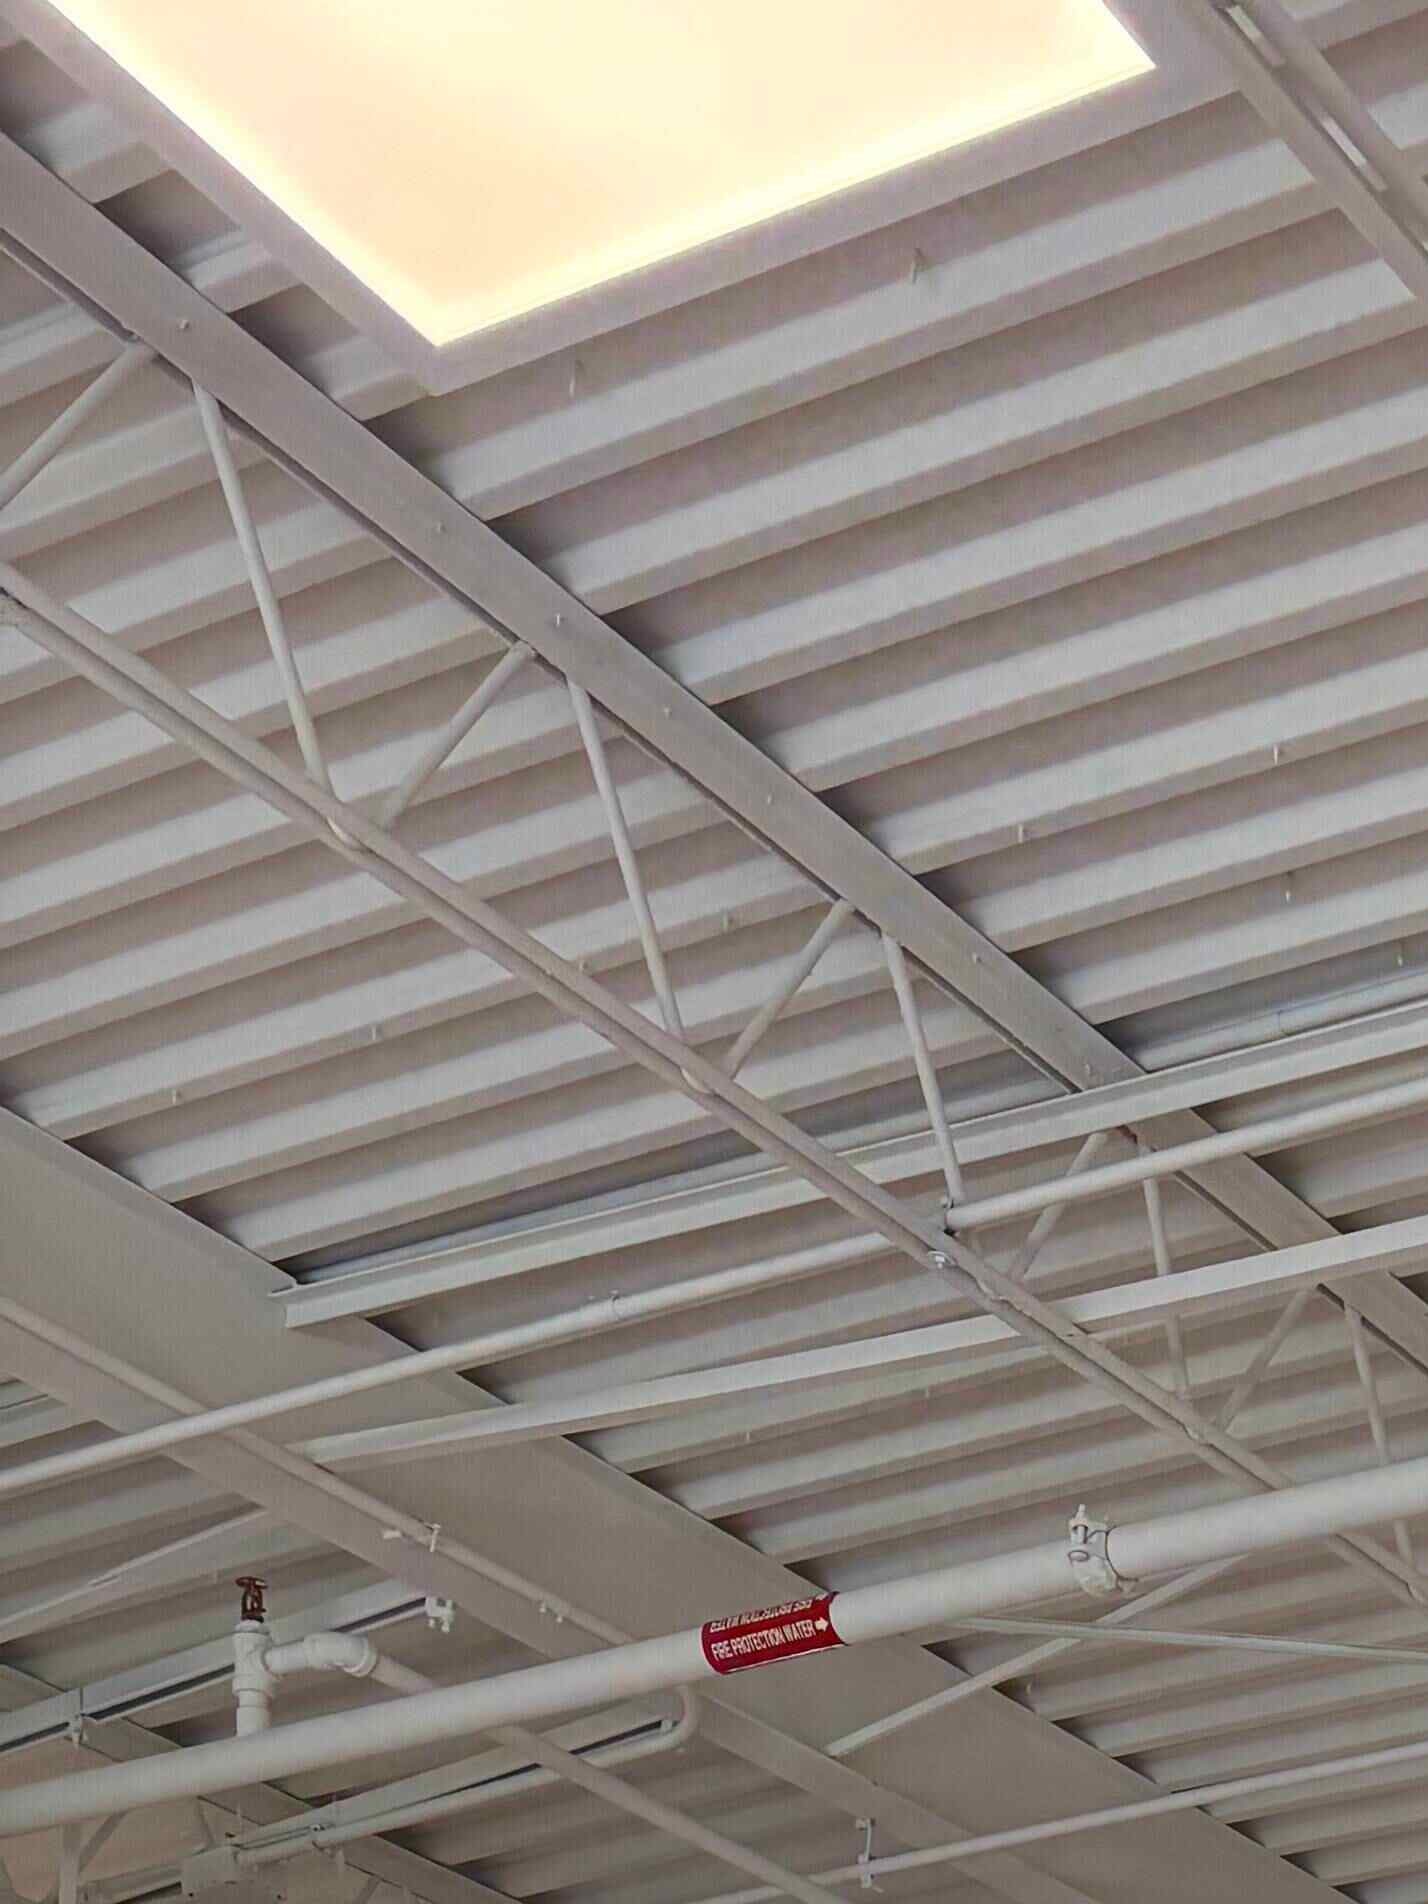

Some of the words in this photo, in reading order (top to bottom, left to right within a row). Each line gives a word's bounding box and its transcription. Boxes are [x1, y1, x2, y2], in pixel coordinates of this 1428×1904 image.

[711, 1639, 732, 1661] FIRE
[731, 1628, 784, 1655] PROTECTION
[784, 1619, 816, 1643] WATER
